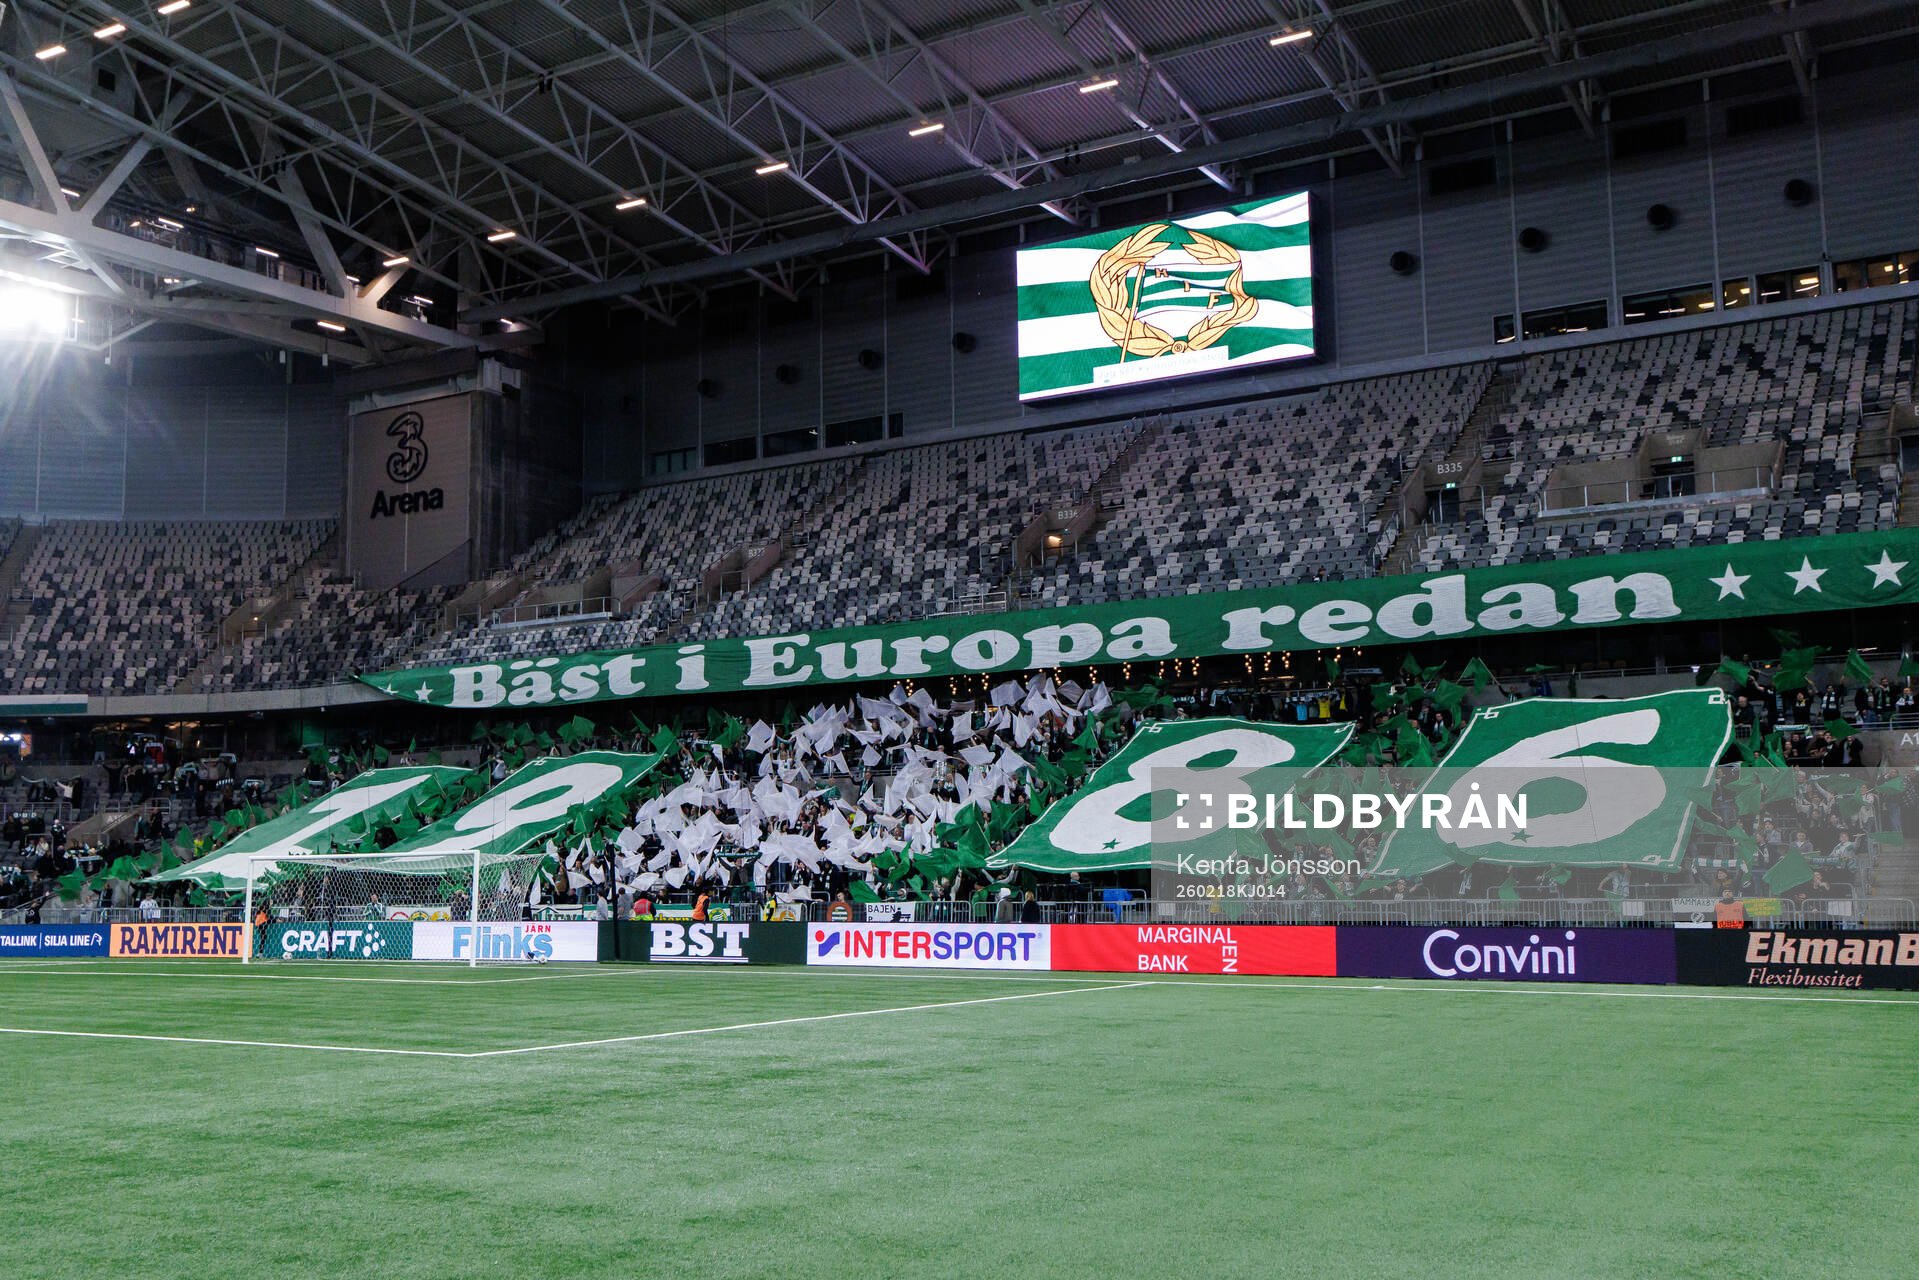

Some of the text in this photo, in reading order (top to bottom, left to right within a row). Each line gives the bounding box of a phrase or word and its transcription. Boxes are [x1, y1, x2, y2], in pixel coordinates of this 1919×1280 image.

[386, 411, 428, 483] 3
[1437, 462, 1463, 474] B335
[370, 487, 444, 519] Arena
[446, 572, 1682, 708] Bäst i Europa redan
[1049, 728, 1296, 855] 8
[1437, 709, 1667, 848] 6
[398, 762, 623, 860] 9
[867, 904, 896, 914] BAJEN
[0, 935, 37, 947] TALLINK
[70, 935, 90, 947] LINE
[119, 926, 242, 955] RAMIRENT
[282, 929, 365, 953] CRAFT
[452, 926, 553, 959] Flinks
[650, 923, 749, 957] BST
[844, 930, 1036, 961] INTERSPORT
[1423, 929, 1576, 977] Convini
[1138, 954, 1189, 971] BANK
[1747, 967, 1863, 987] Flexibussitet
